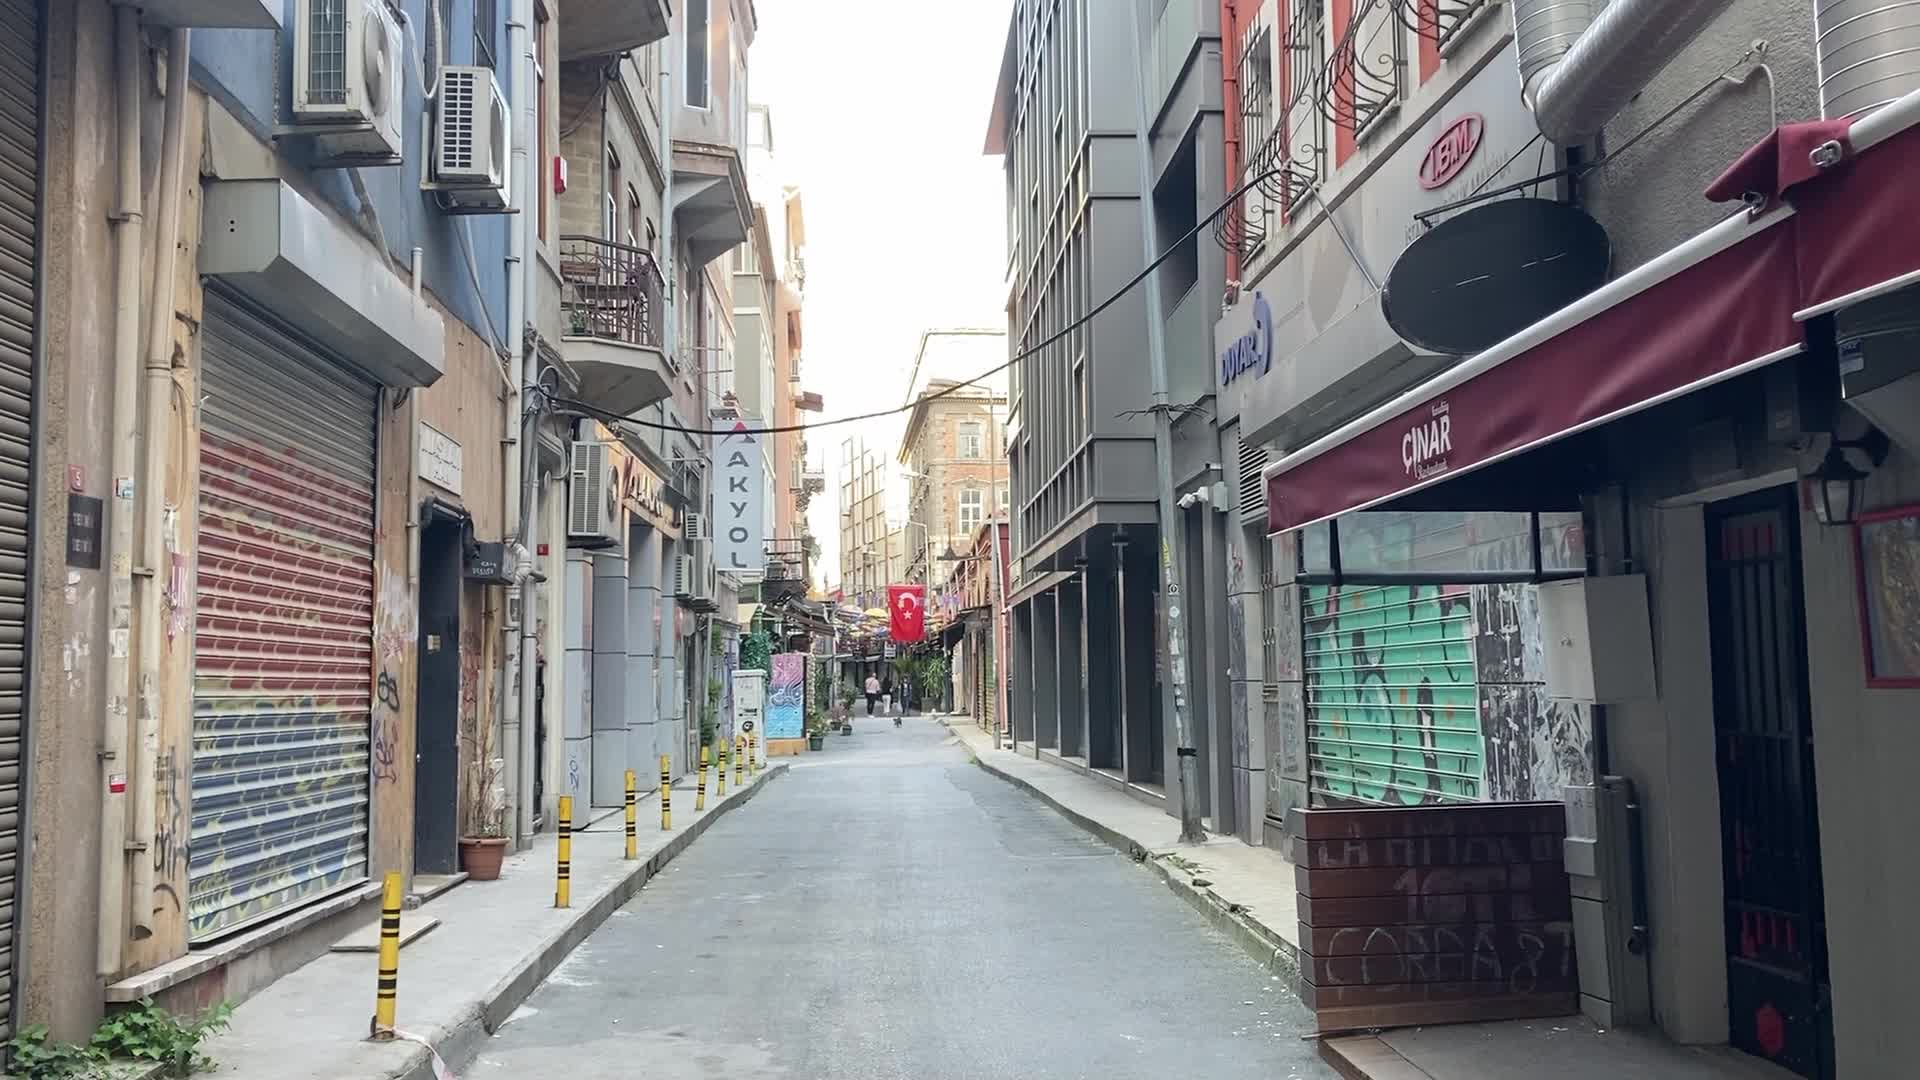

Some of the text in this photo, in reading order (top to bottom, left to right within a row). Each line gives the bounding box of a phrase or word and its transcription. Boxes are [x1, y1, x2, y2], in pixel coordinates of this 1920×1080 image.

[1221, 335, 1258, 386] DUYAR
[1402, 414, 1452, 478] ÇINAR
[727, 450, 749, 569] AKYOL
